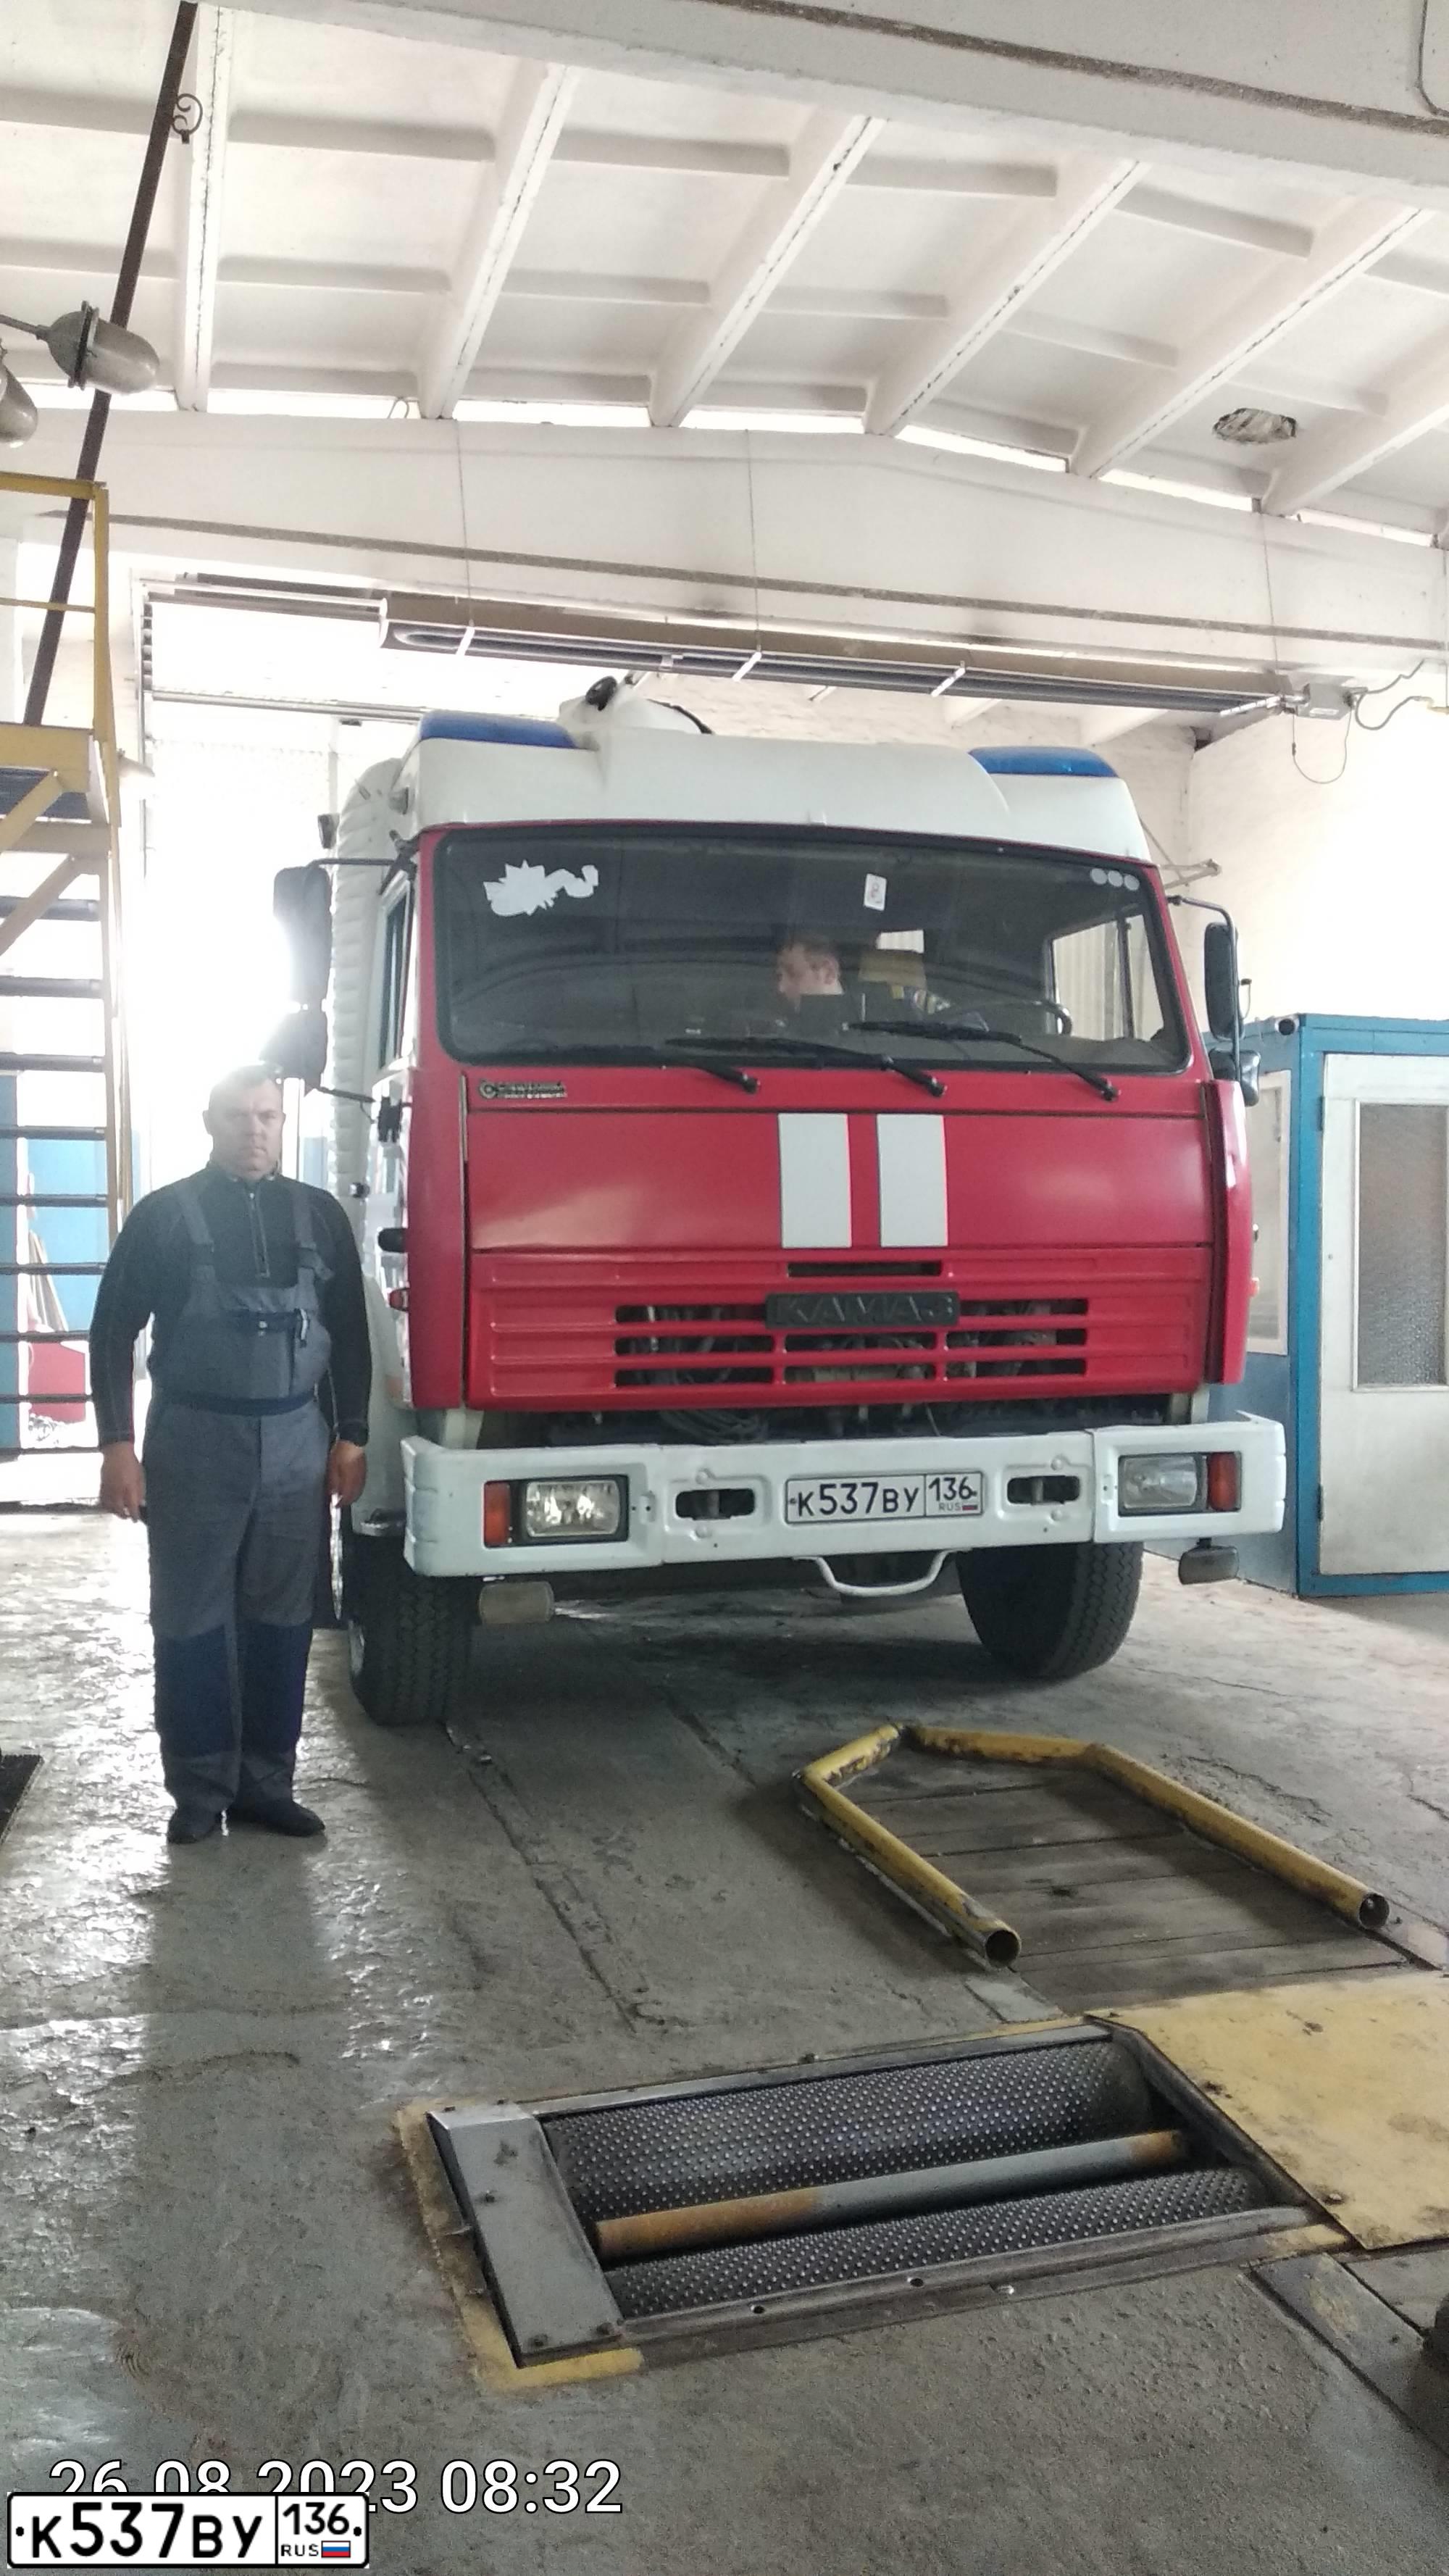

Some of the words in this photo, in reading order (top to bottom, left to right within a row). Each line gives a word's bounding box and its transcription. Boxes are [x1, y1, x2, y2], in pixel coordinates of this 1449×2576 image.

[798, 1482, 919, 1517] К537ВУ
[928, 1476, 973, 1501] 136
[938, 1502, 961, 1512] RUS
